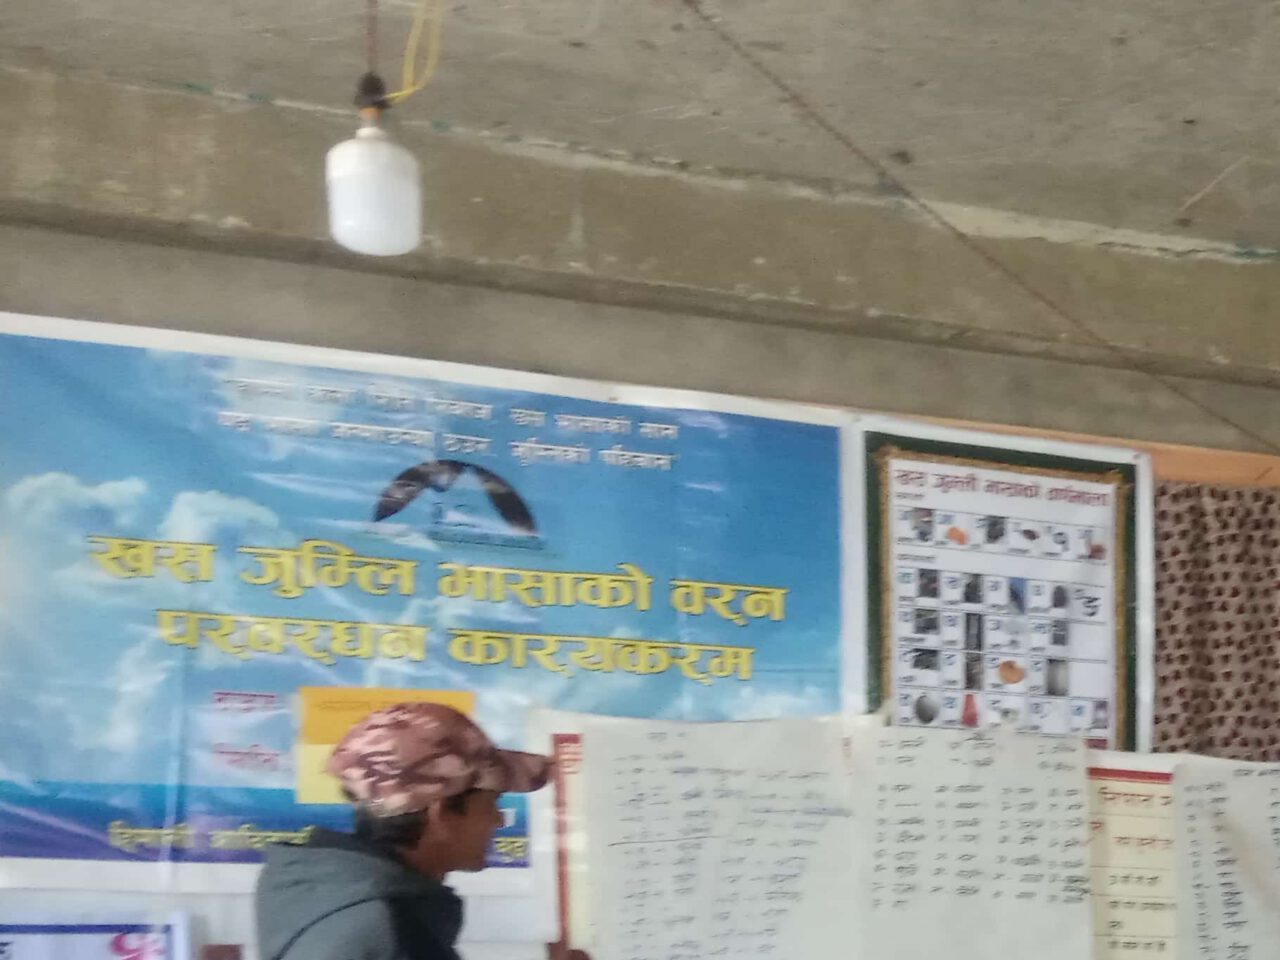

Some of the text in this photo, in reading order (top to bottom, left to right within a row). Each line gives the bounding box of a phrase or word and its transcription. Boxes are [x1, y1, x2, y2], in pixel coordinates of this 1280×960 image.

[87, 535, 219, 584] खस
[236, 538, 418, 599] जुम्लि
[437, 562, 656, 612] भासाको
